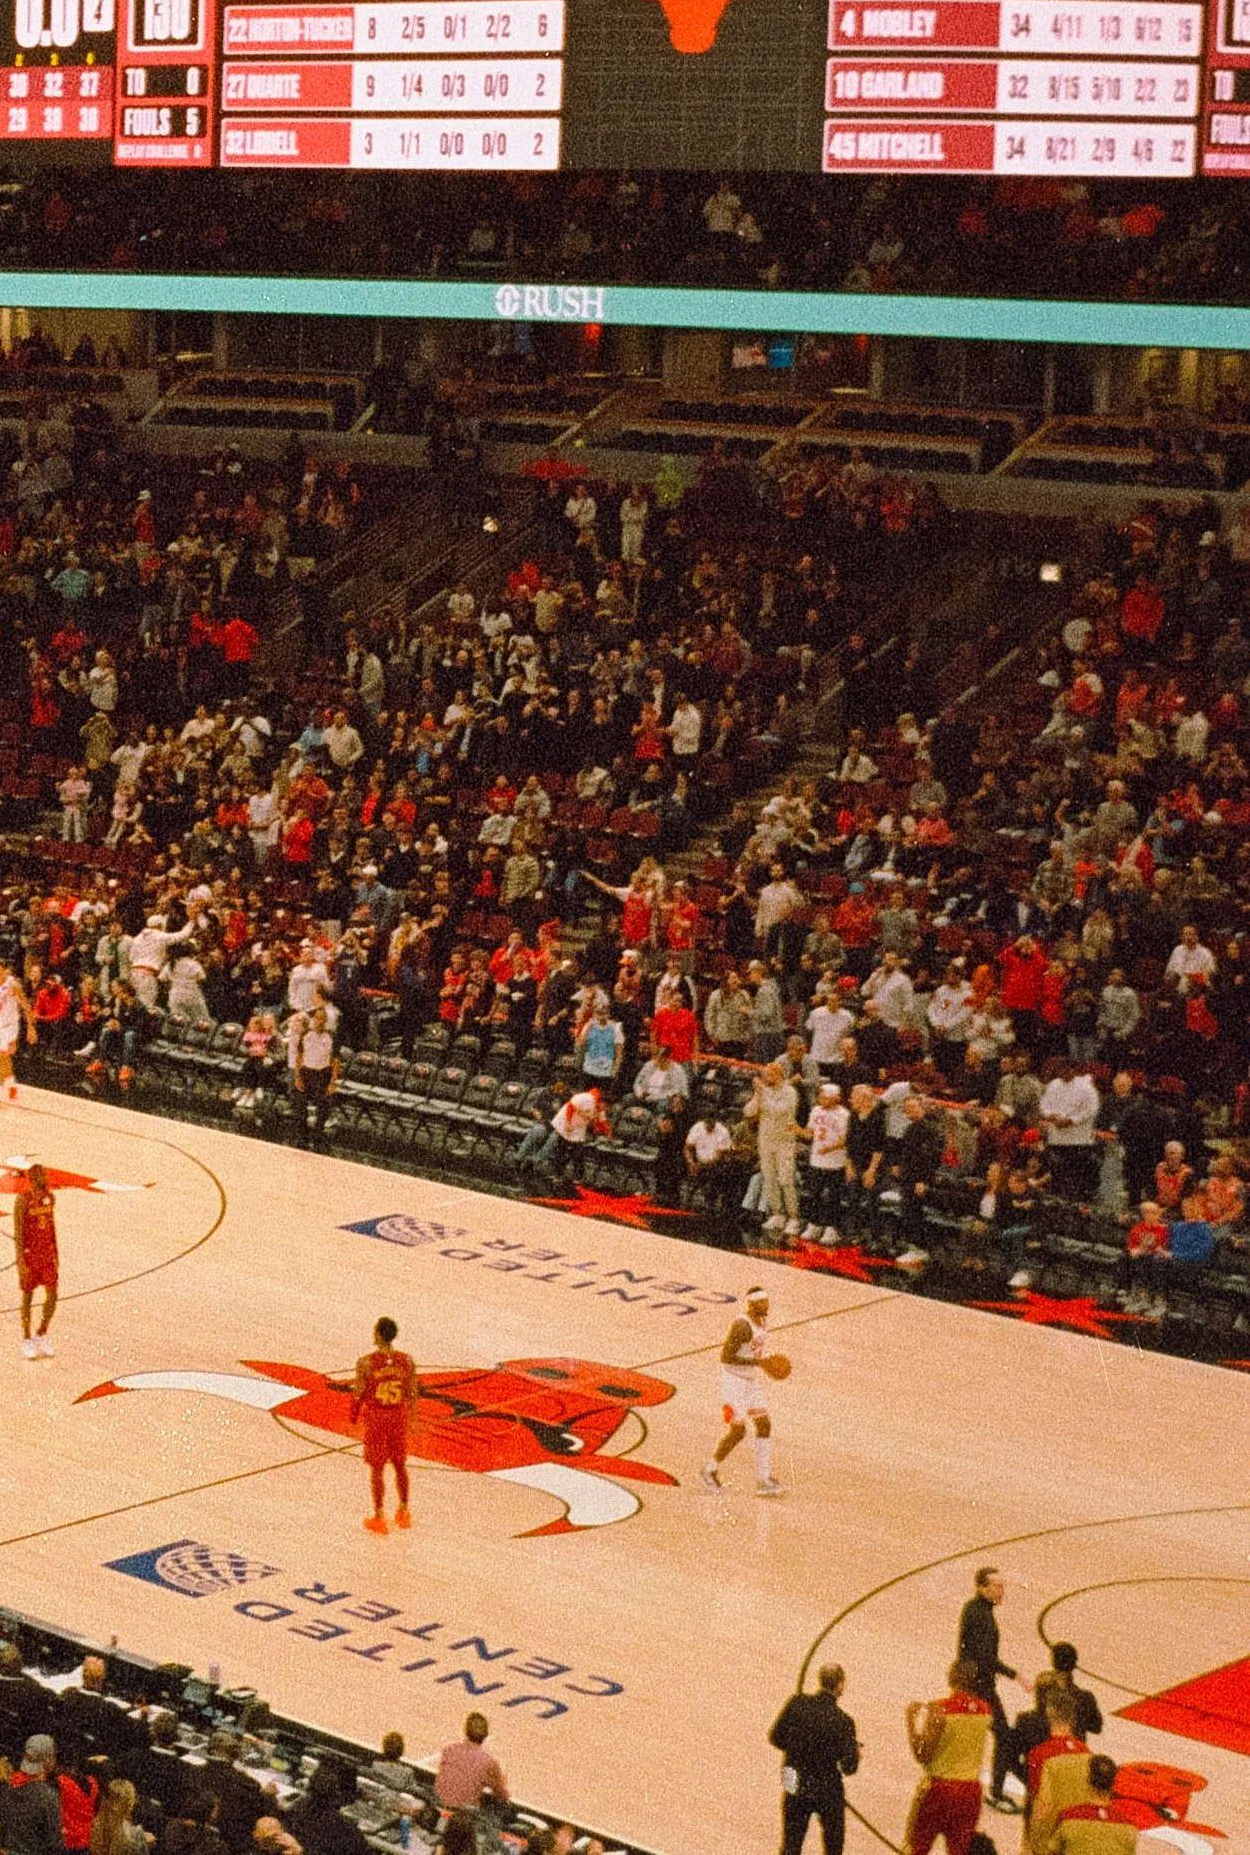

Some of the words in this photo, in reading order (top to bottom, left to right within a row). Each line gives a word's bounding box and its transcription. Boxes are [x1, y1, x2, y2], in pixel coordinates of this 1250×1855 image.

[227, 17, 249, 43] 22
[249, 16, 354, 42] HORTON-TUCKER
[367, 17, 378, 40] 8
[401, 16, 426, 40] 2/5
[443, 15, 467, 40] 0/1
[486, 14, 511, 40] 2/2
[537, 13, 549, 38] 6
[840, 9, 856, 37] 4
[863, 10, 936, 37] MOBLEY
[1012, 13, 1031, 37] 34
[79, 71, 100, 97] 37
[126, 68, 146, 96] TO
[226, 73, 248, 100] 27
[248, 74, 300, 99] DUARTE
[365, 74, 377, 98] 9
[402, 75, 423, 95] 1/4
[441, 74, 466, 98] 0/3
[484, 73, 509, 98] 0/0
[534, 73, 547, 97] 2
[834, 70, 860, 99] 10
[859, 71, 943, 99] GARLAND
[1009, 74, 1029, 100] 32
[125, 109, 170, 135] FOULS
[185, 107, 199, 136] 5
[223, 129, 247, 156] 32
[246, 130, 299, 155] LIDDELL
[363, 132, 374, 155] 3
[399, 132, 421, 155] 1/1
[439, 132, 464, 156] 0/0
[482, 132, 507, 156] 0/0
[532, 132, 545, 156] 2
[828, 132, 859, 161] 45
[858, 133, 944, 160] MITCHELL
[1006, 136, 1026, 160] 34
[524, 287, 604, 318] RUSH
[439, 1247, 699, 1315] UNITED
[481, 1238, 736, 1305] CENTER
[374, 1380, 403, 1405] 45
[292, 1582, 625, 1696] CENTER
[233, 1600, 570, 1720] UNITED
